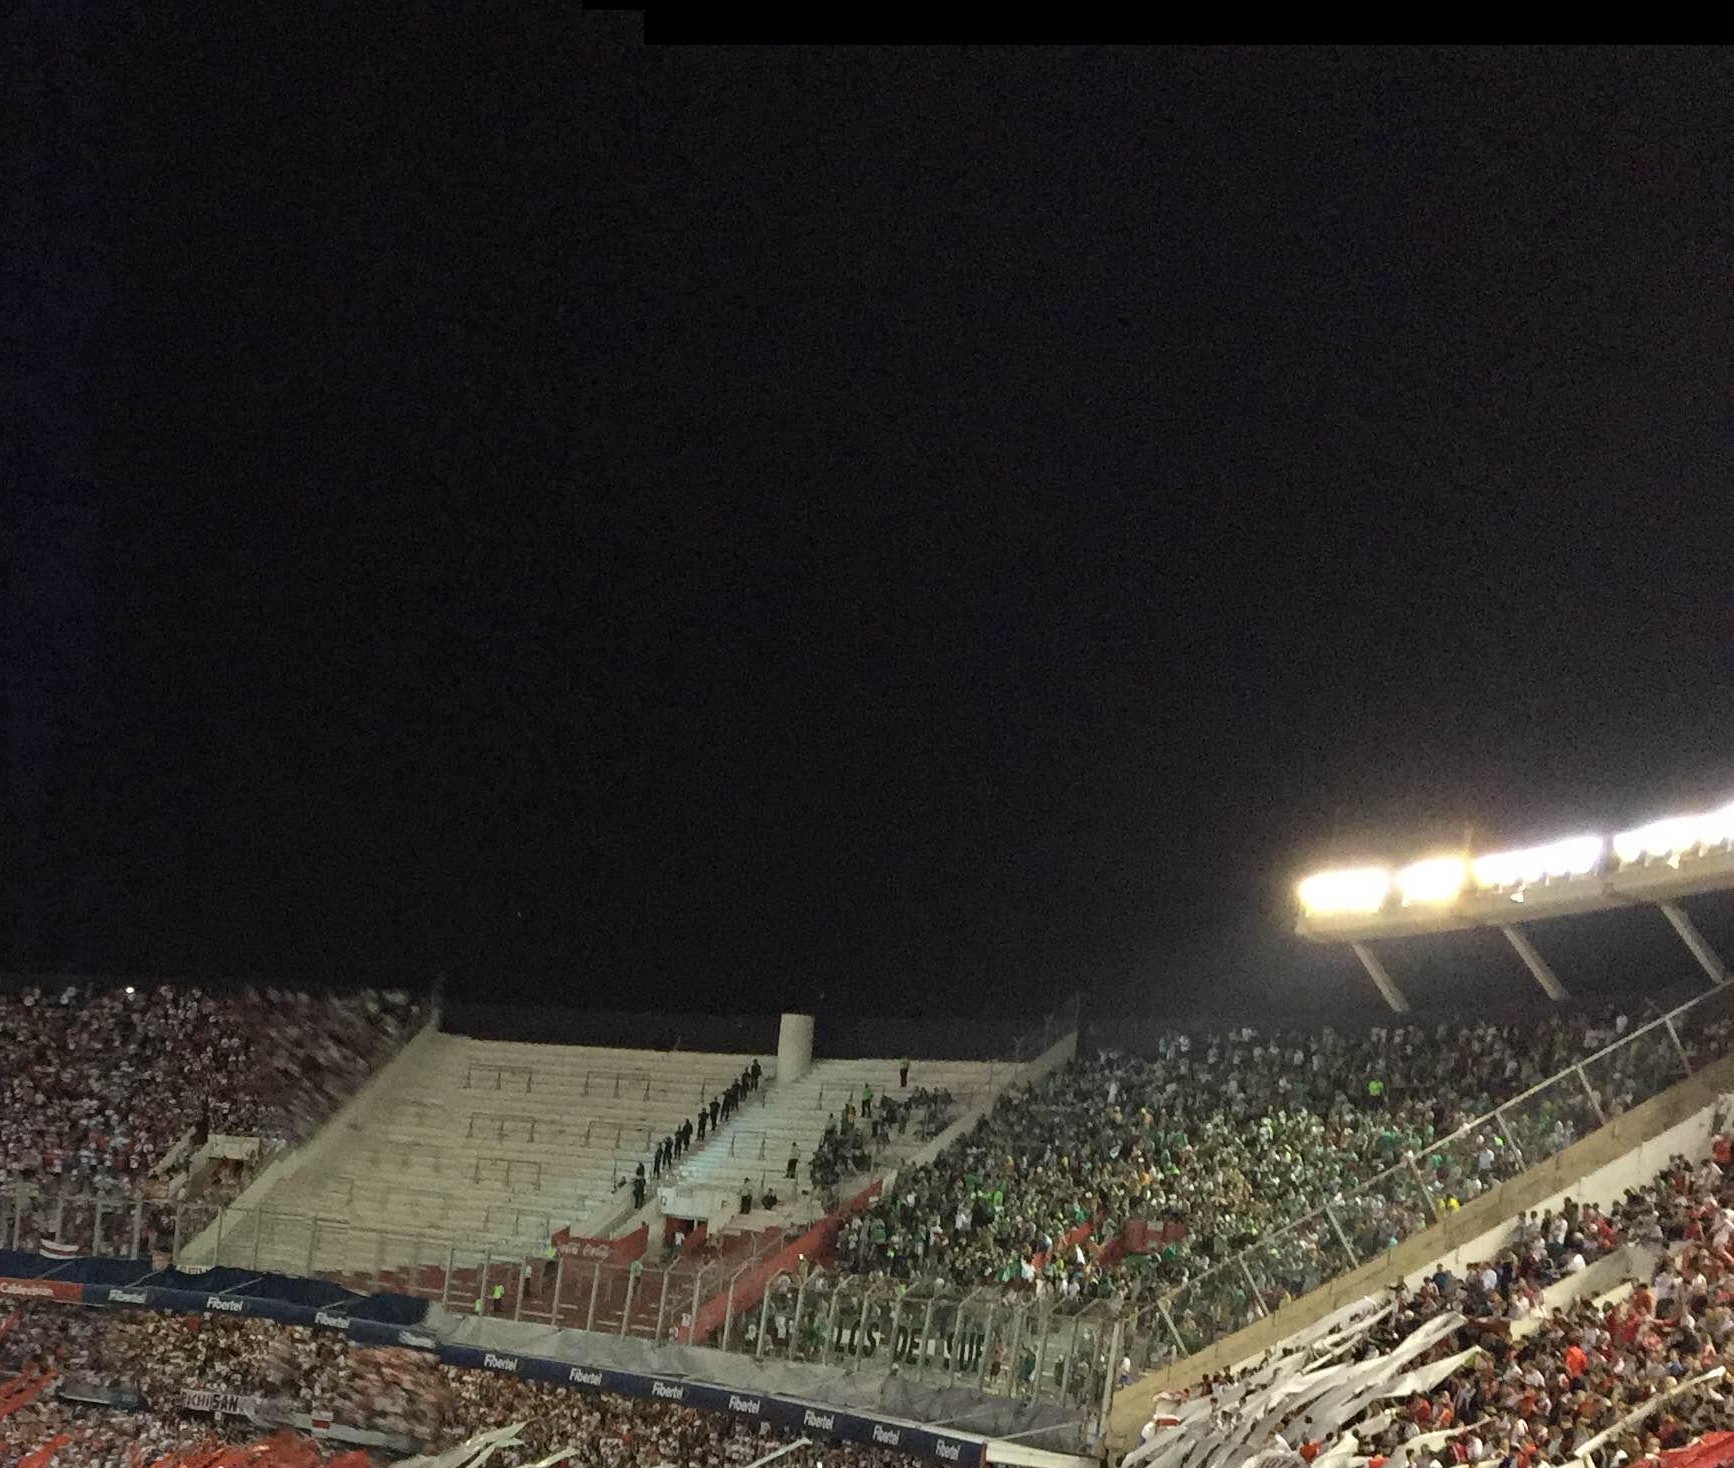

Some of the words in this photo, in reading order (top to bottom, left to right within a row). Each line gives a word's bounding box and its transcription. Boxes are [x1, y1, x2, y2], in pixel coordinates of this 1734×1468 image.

[207, 1296, 243, 1312] Fibertel
[484, 1354, 517, 1371] Fibertel
[570, 1368, 602, 1385] Fibertel
[652, 1382, 683, 1399] Fibertel
[213, 1394, 239, 1412] SAN
[729, 1396, 760, 1414] Fibertel
[804, 1410, 834, 1429] Fibertel
